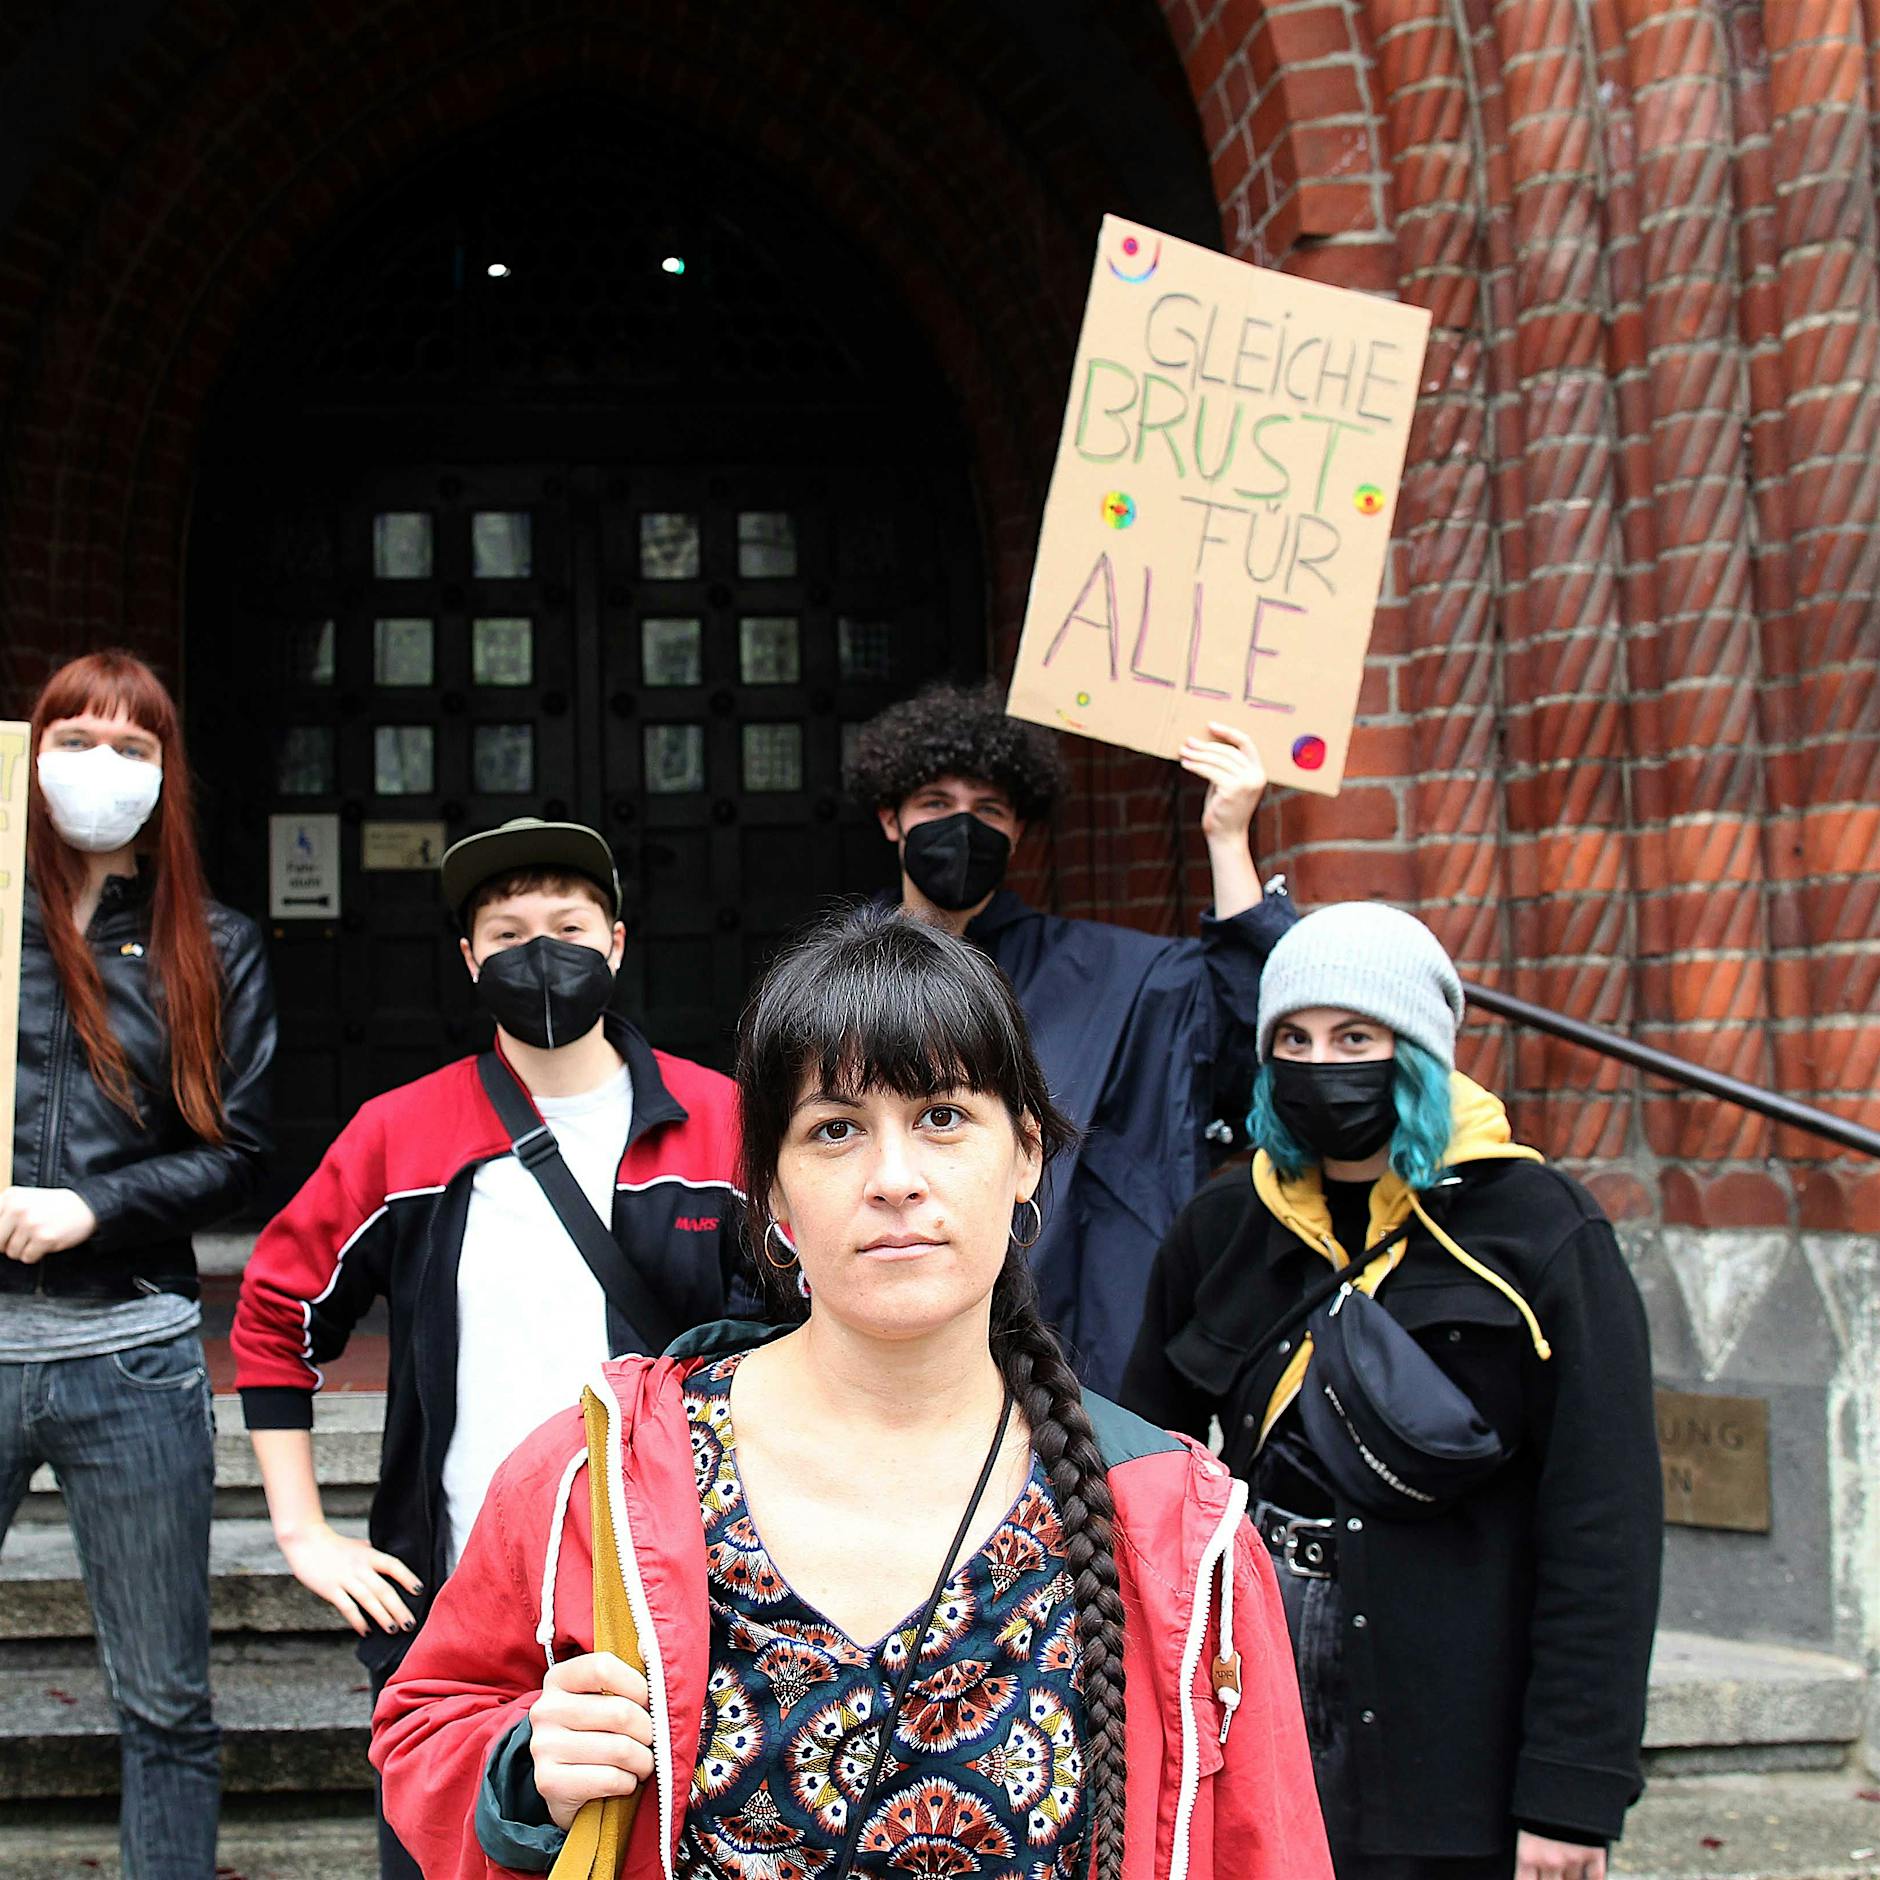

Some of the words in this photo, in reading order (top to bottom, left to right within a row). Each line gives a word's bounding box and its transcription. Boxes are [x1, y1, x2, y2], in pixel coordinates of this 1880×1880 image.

[1075, 358, 1376, 513] BRUST
[1180, 496, 1342, 596] FÜR
[1043, 551, 1309, 712] ALLE
[674, 1216, 720, 1232] MARS
